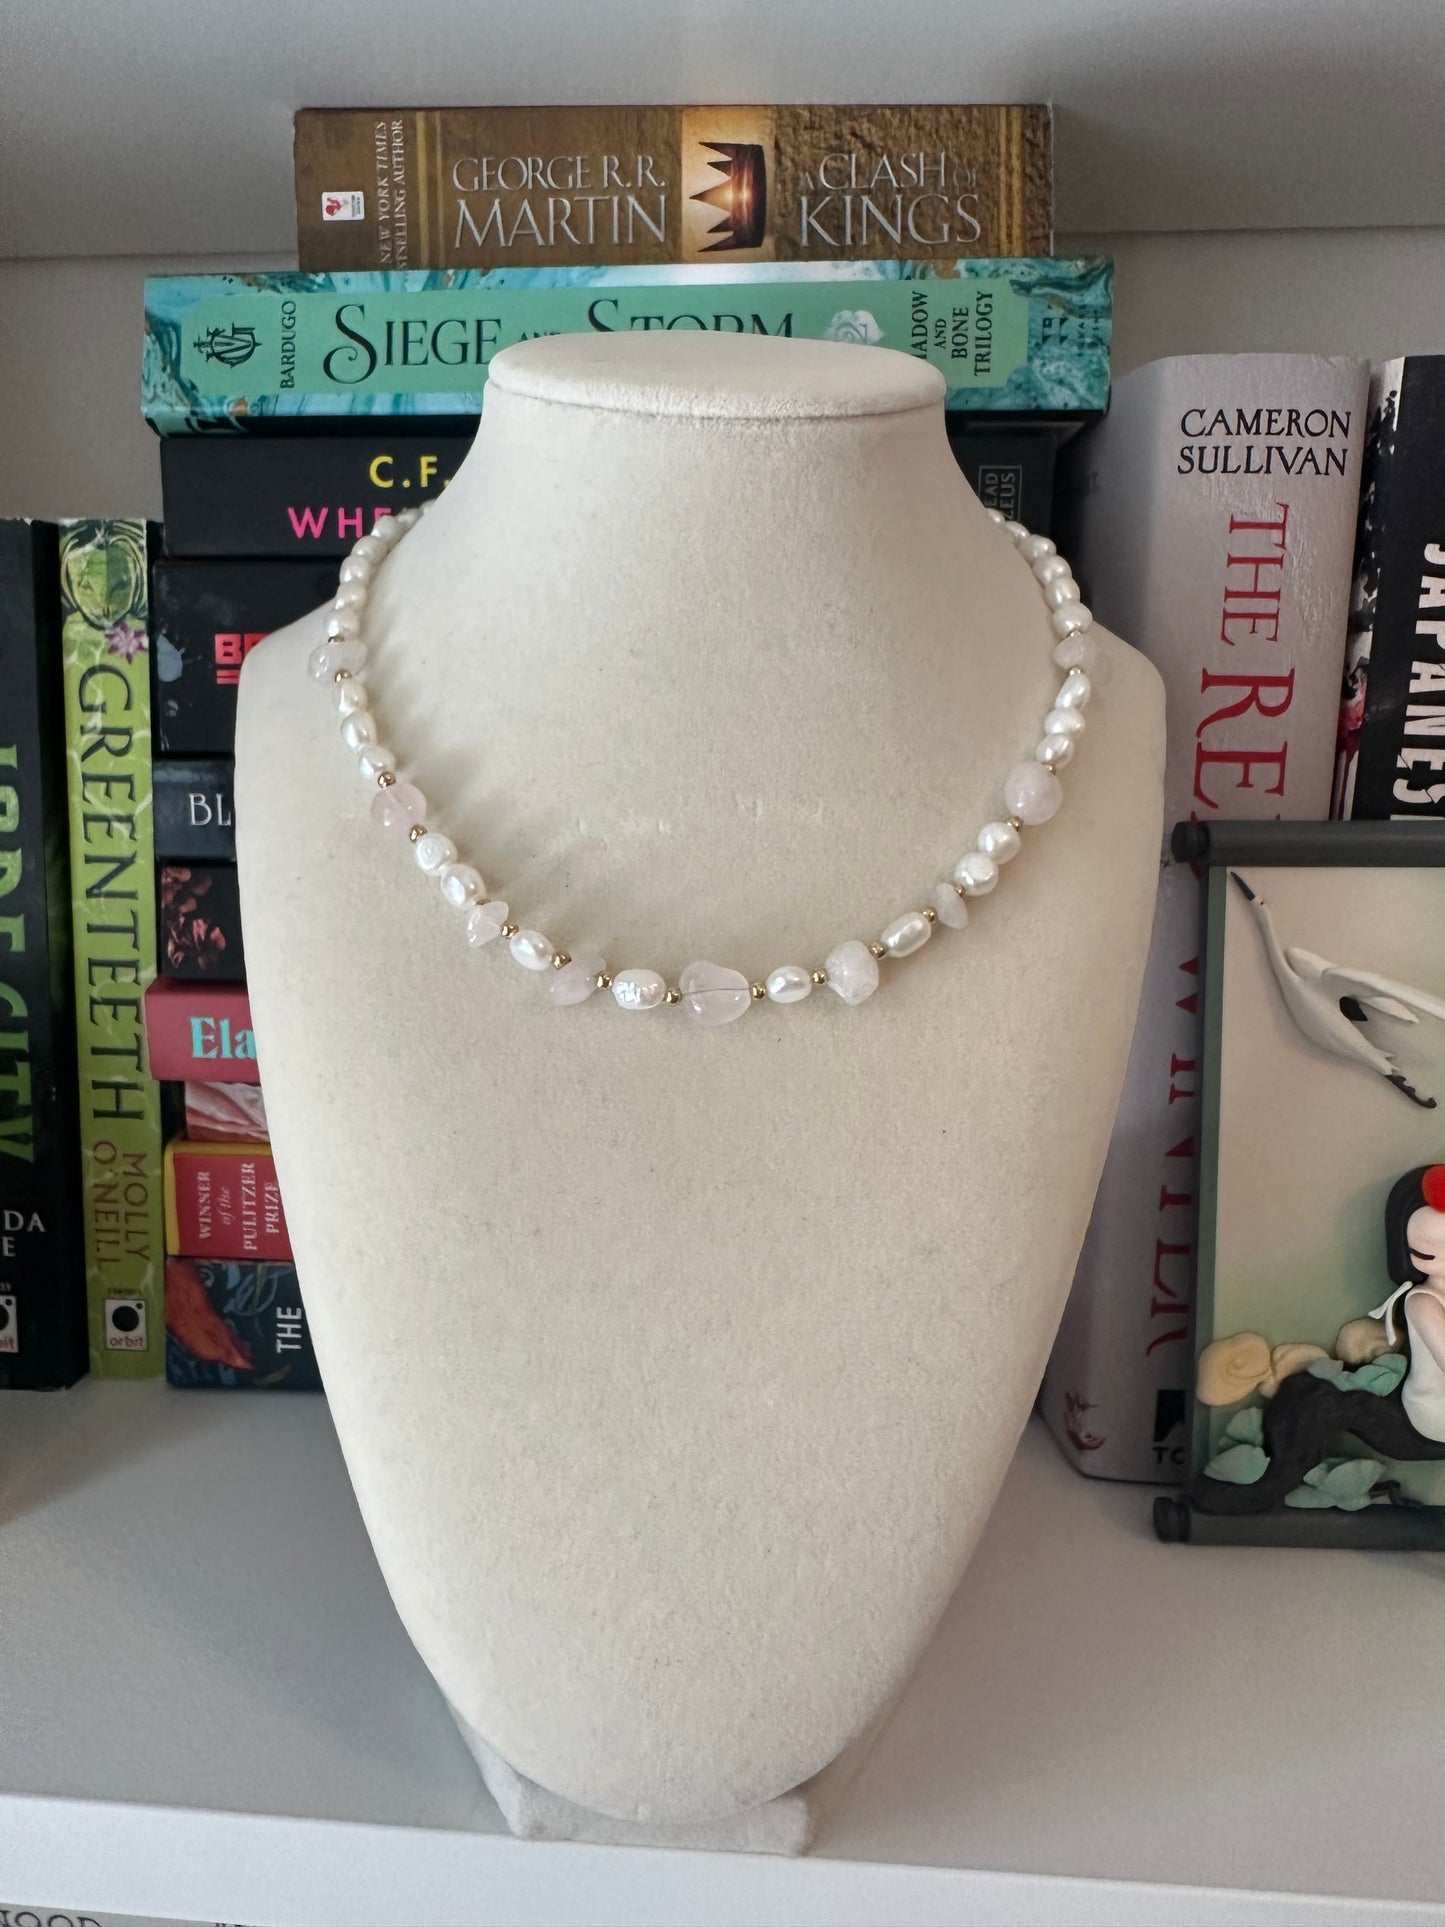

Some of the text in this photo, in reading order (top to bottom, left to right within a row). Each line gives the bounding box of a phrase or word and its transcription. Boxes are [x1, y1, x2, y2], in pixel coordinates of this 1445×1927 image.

[374, 121, 388, 171] TIMES
[391, 119, 406, 185] AUTHOR
[819, 152, 945, 190] CLASH
[376, 176, 390, 221] YORK
[452, 156, 592, 191] GEORGE
[455, 195, 666, 248] MARTIN
[800, 193, 982, 247] KINGS
[280, 300, 297, 390] BARDUGO
[934, 318, 947, 350] AND
[951, 306, 969, 360] BONE
[974, 290, 993, 377] TRILOGY
[1181, 408, 1352, 439] CAMERON
[1177, 445, 1348, 476] SULLIVAN
[1221, 503, 1289, 646] THE
[78, 664, 145, 1119] GREENTEETH
[92, 1140, 121, 1269] O'NEILL
[122, 1152, 150, 1261] MOLLY
[197, 1171, 212, 1239] WINNER
[241, 1162, 257, 1250] PULITZER
[264, 1183, 280, 1234] PRIZE
[109, 1336, 144, 1348] orbit
[276, 1306, 303, 1354] THE
